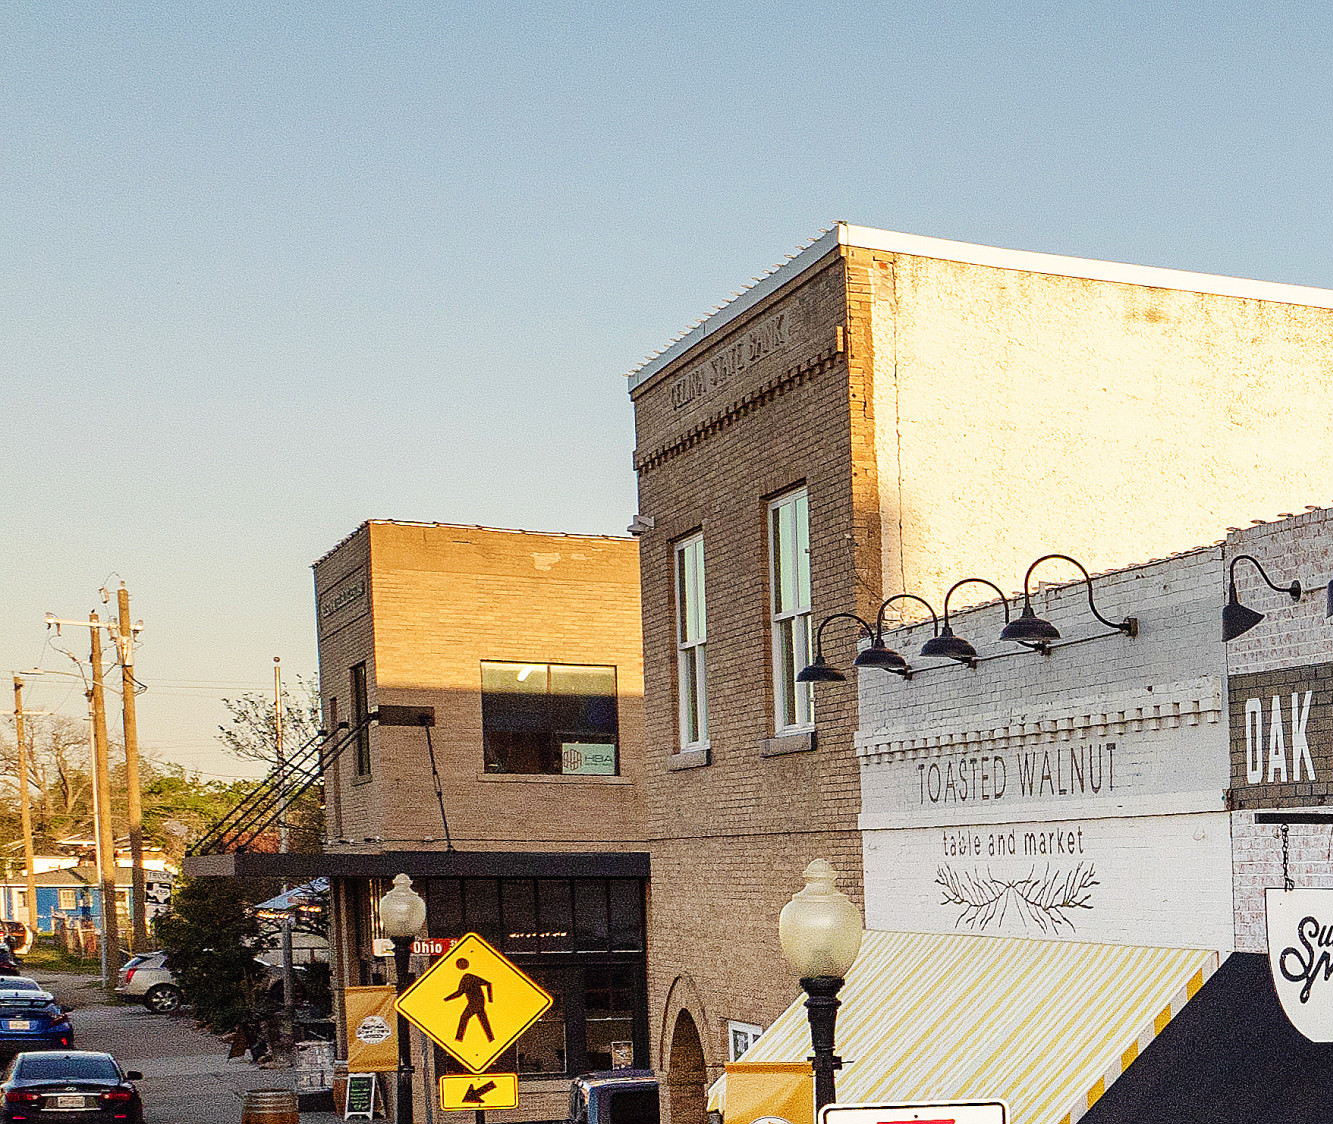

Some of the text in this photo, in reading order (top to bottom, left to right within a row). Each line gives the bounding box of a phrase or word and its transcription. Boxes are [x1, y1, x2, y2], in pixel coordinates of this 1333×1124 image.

[1245, 690, 1316, 784] OAK
[918, 743, 1116, 805] TOASTED WALNUT
[943, 826, 1084, 856] table and market
[413, 941, 442, 954] Ohio
